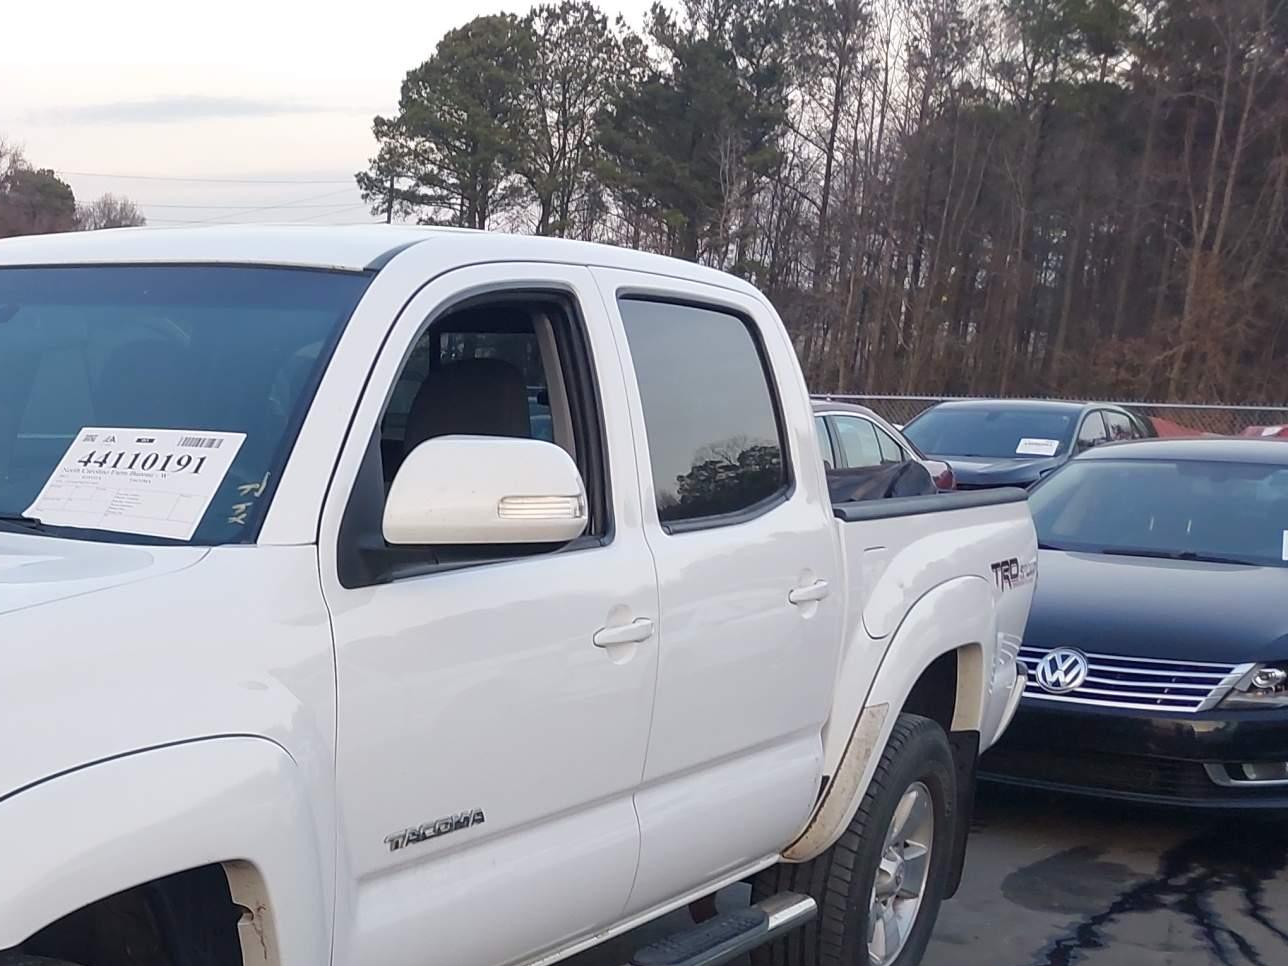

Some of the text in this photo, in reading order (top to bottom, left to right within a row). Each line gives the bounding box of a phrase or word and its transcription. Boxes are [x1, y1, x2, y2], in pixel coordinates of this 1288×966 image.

[78, 450, 208, 474] 44110191
[991, 557, 1019, 592] TRD
[384, 808, 486, 852] TACOMA
